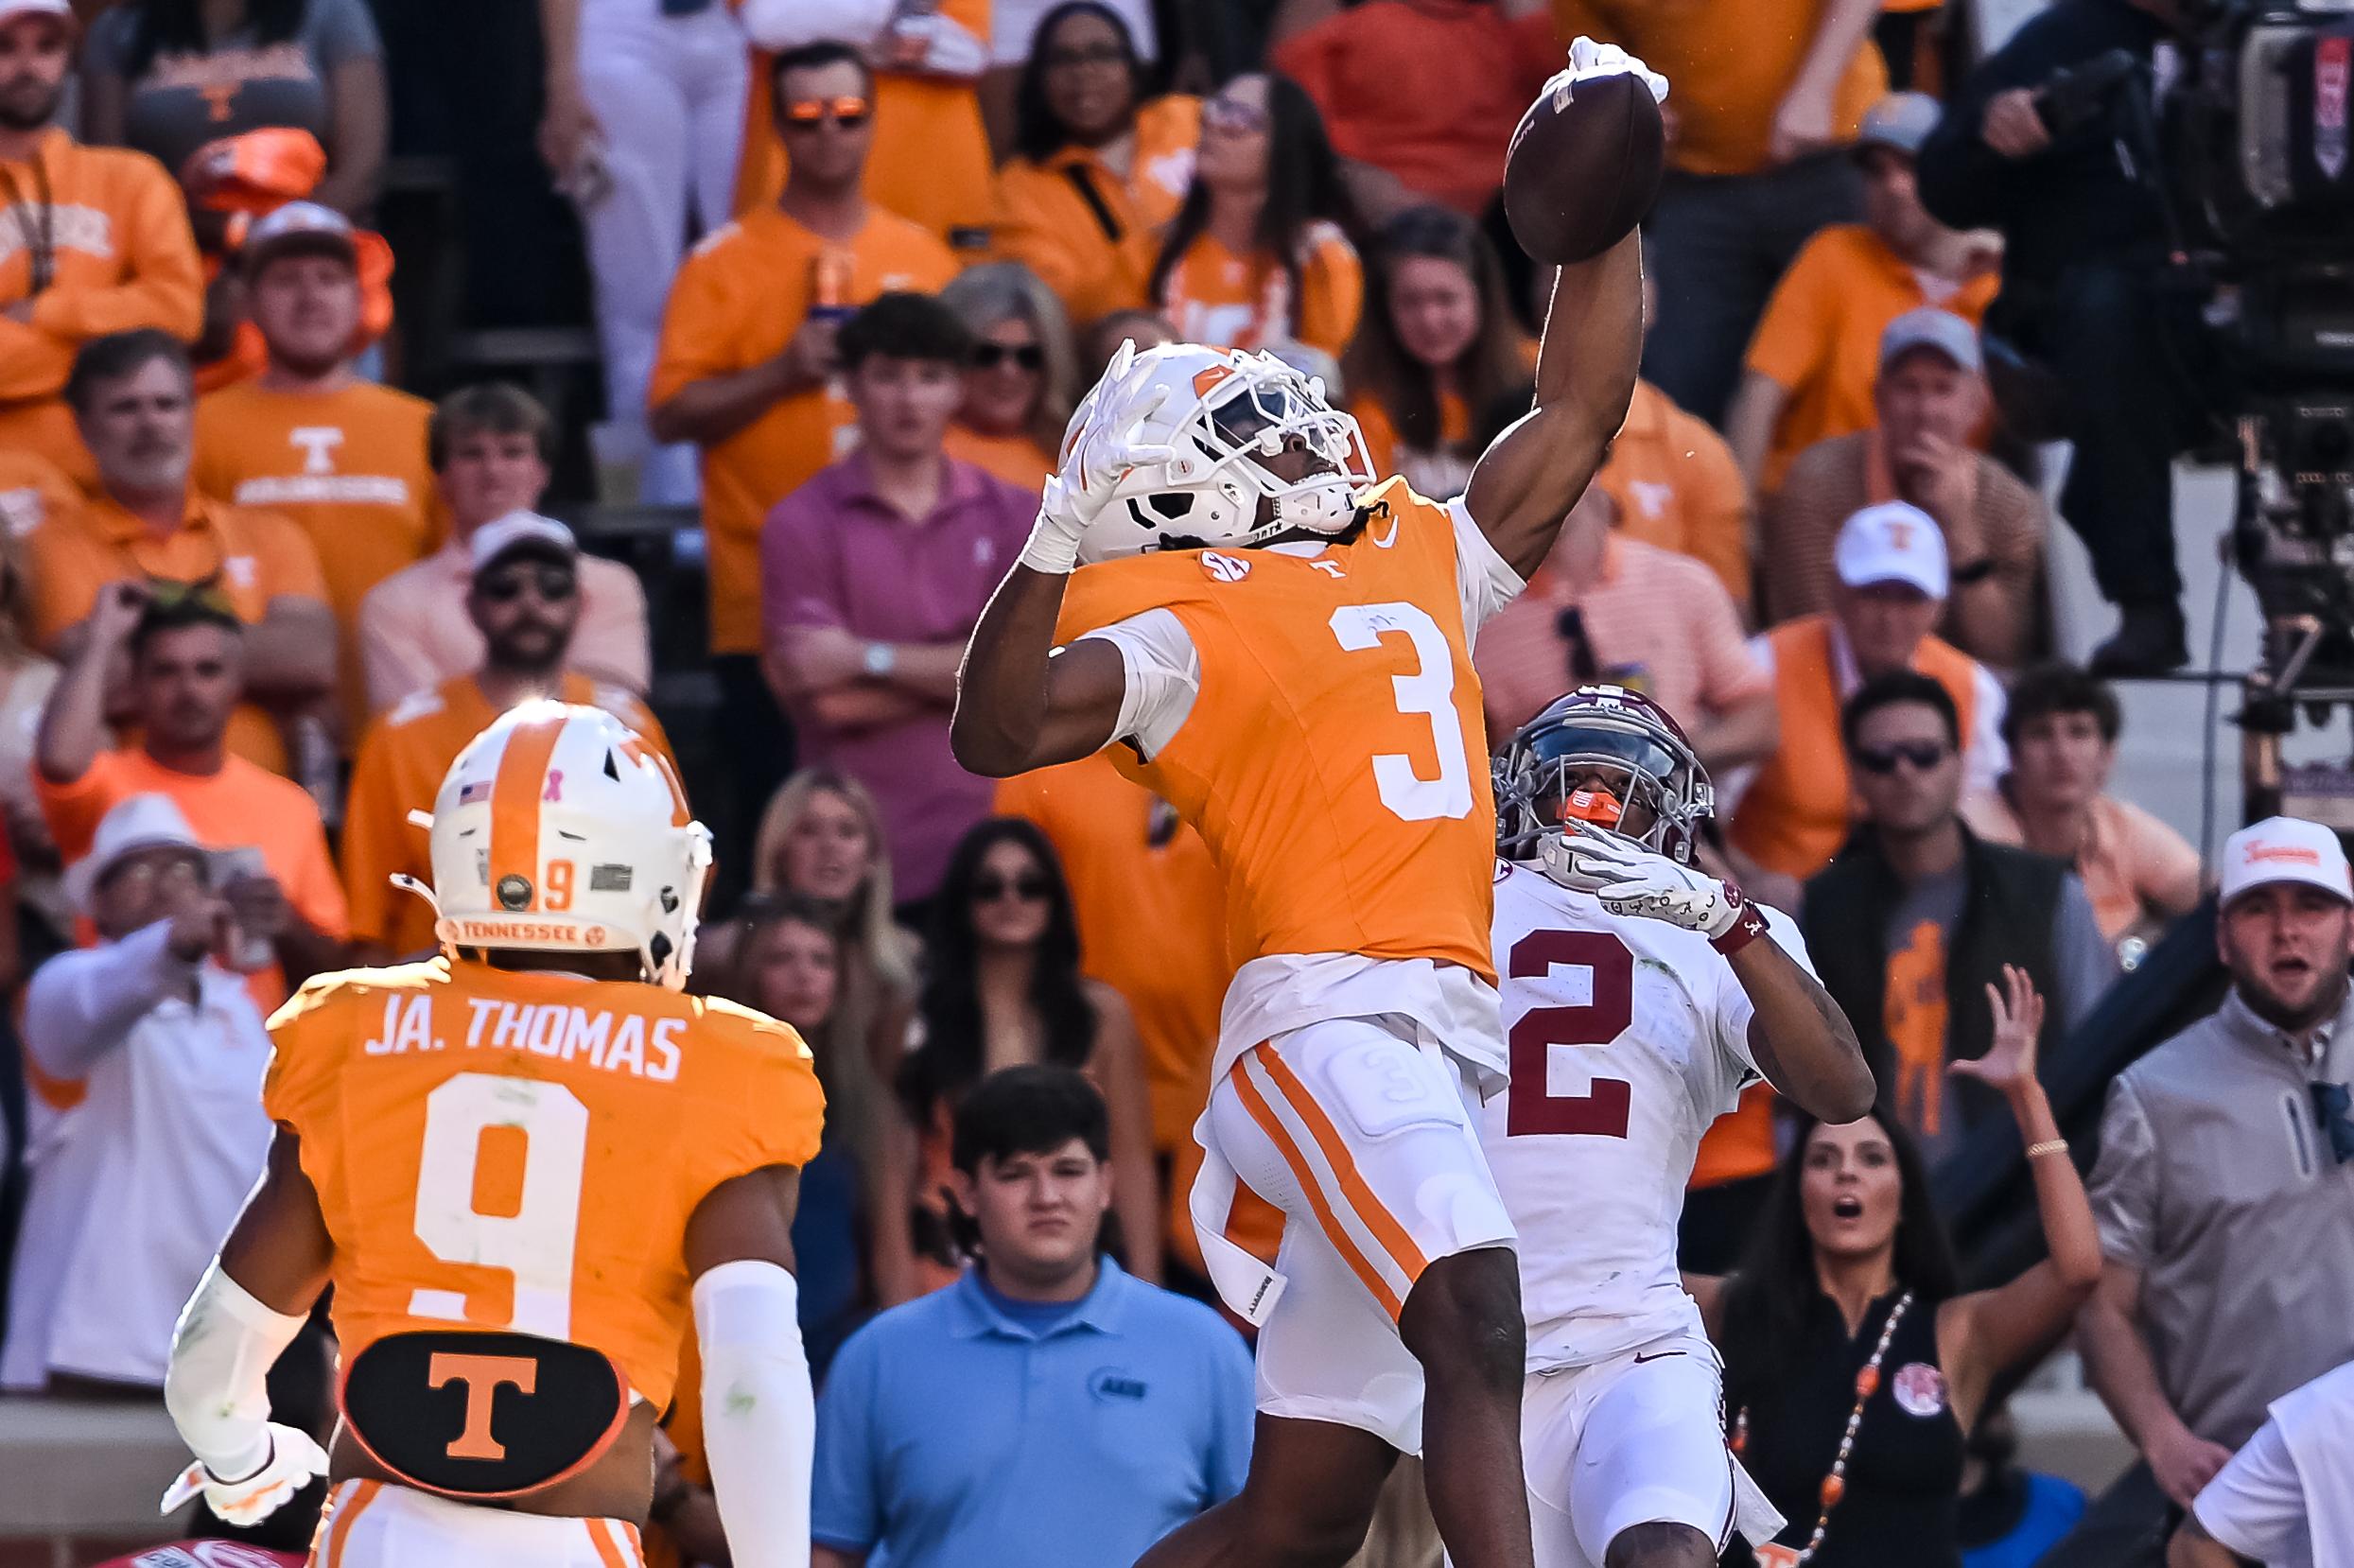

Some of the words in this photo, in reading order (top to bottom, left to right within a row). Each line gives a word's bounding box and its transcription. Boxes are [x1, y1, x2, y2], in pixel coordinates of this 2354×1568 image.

[289, 427, 344, 475] T
[1309, 560, 1347, 579] T
[1328, 601, 1474, 822] 3
[545, 858, 573, 913] 9
[463, 920, 577, 942] TENNESSEE
[365, 994, 445, 1054] JA.
[466, 998, 688, 1082] THOMAS
[1506, 929, 1635, 1139] 2
[408, 1071, 589, 1342] 9
[428, 1351, 538, 1460] T
